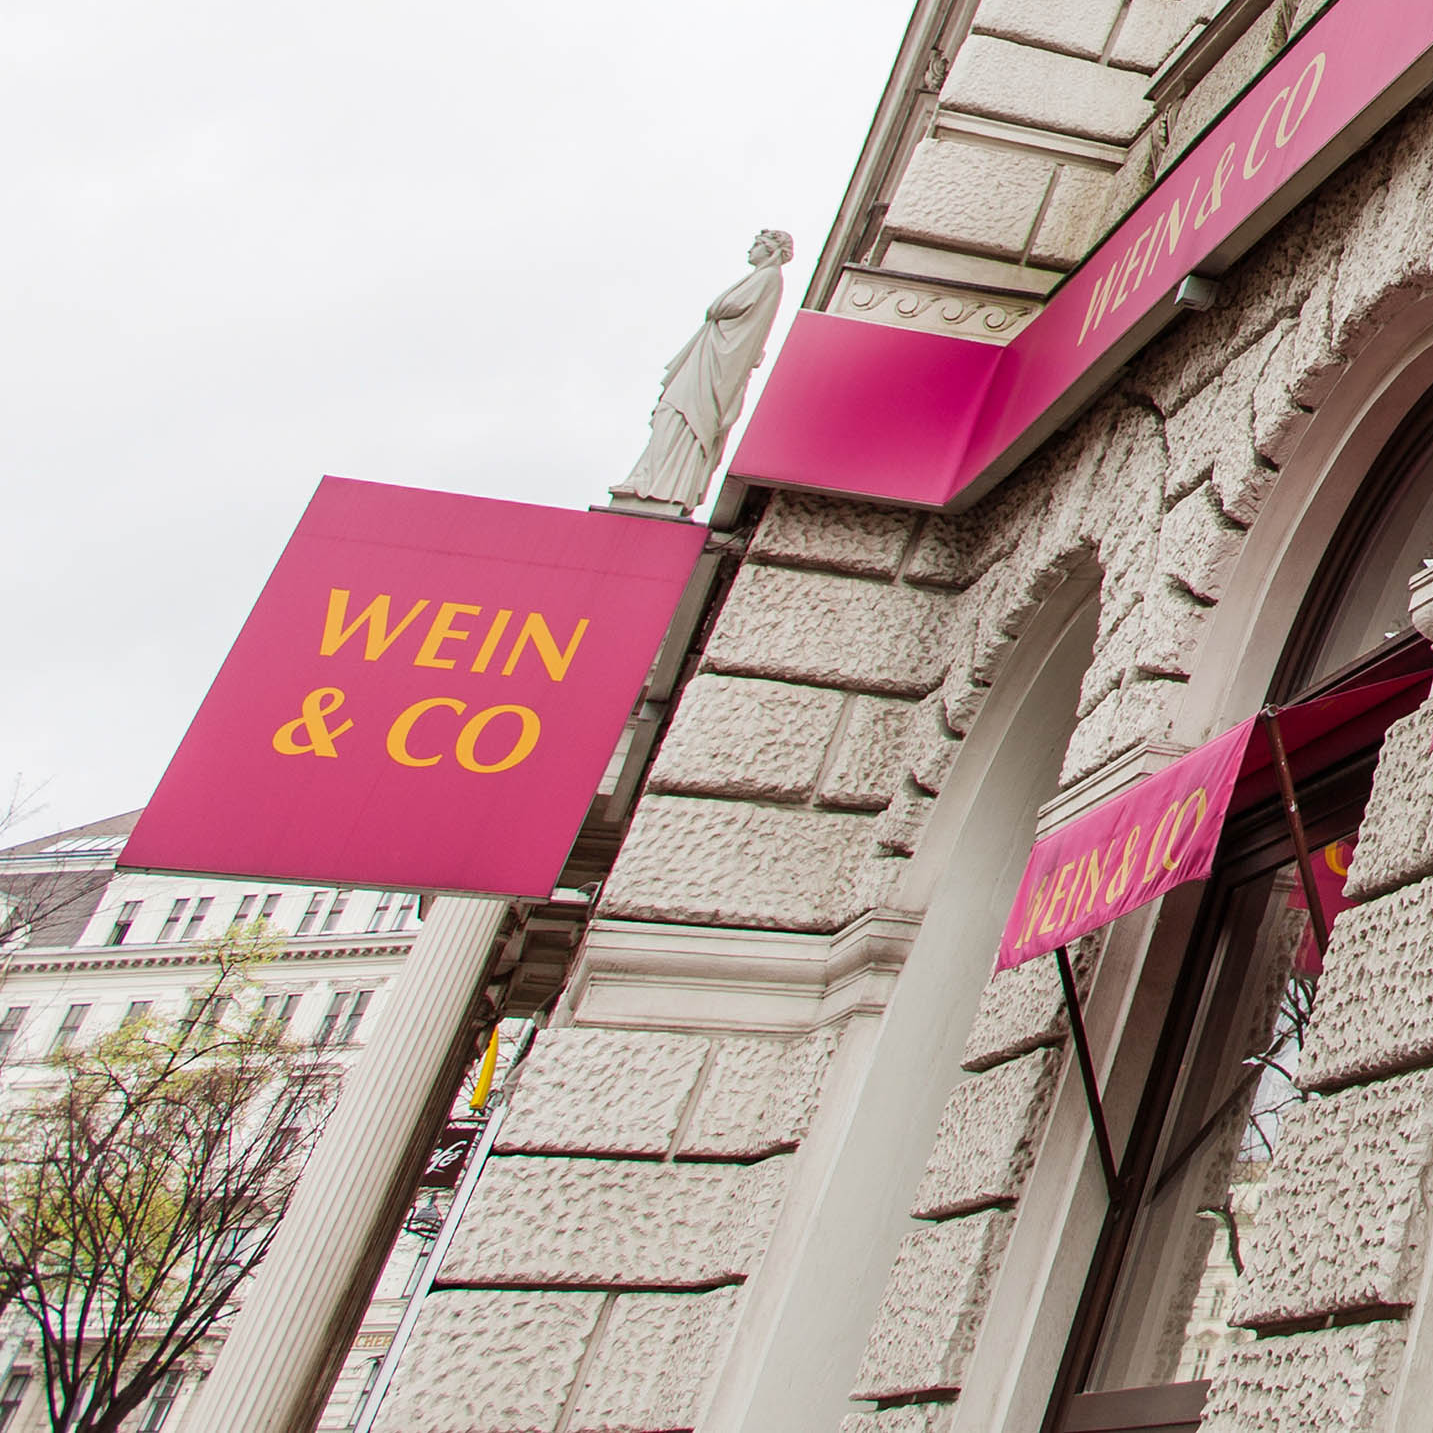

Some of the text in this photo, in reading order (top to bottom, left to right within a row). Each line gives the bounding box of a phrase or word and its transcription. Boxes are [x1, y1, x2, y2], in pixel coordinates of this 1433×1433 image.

[1077, 52, 1327, 345] WEIN & CO
[320, 587, 591, 683] WEIN
[271, 685, 542, 775] & CO
[1014, 786, 1207, 949] WEIN & CO
